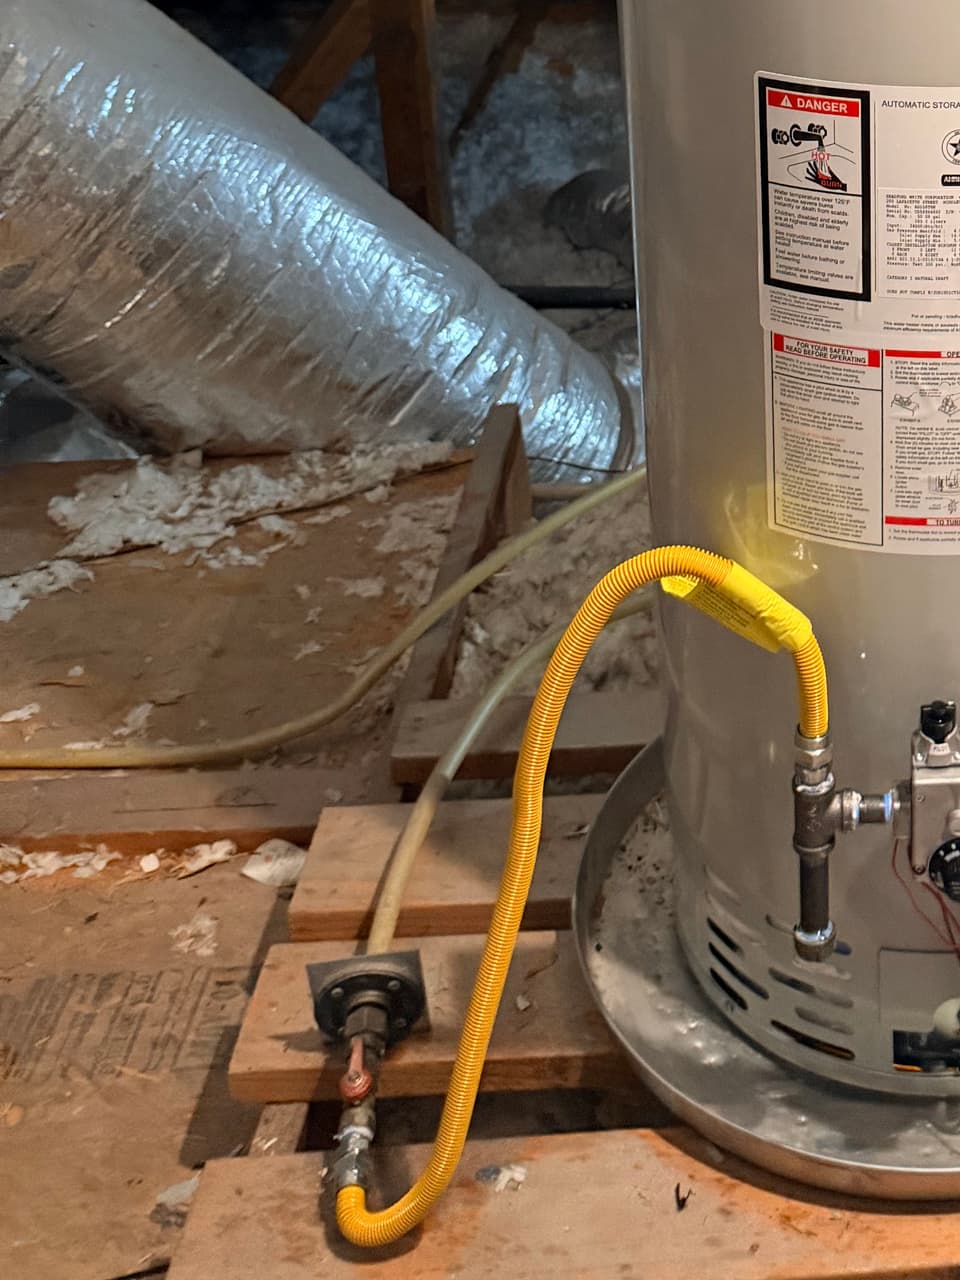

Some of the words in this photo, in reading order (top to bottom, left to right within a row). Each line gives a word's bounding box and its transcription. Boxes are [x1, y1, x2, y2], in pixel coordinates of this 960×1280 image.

[796, 98, 848, 113] DANGER
[882, 100, 930, 108] AUTOMATIC
[811, 152, 831, 160] HOT
[786, 345, 802, 354] READ
[803, 349, 828, 358] BEFORE
[830, 354, 866, 364] OPERATING
[830, 347, 853, 356] SAFETY
